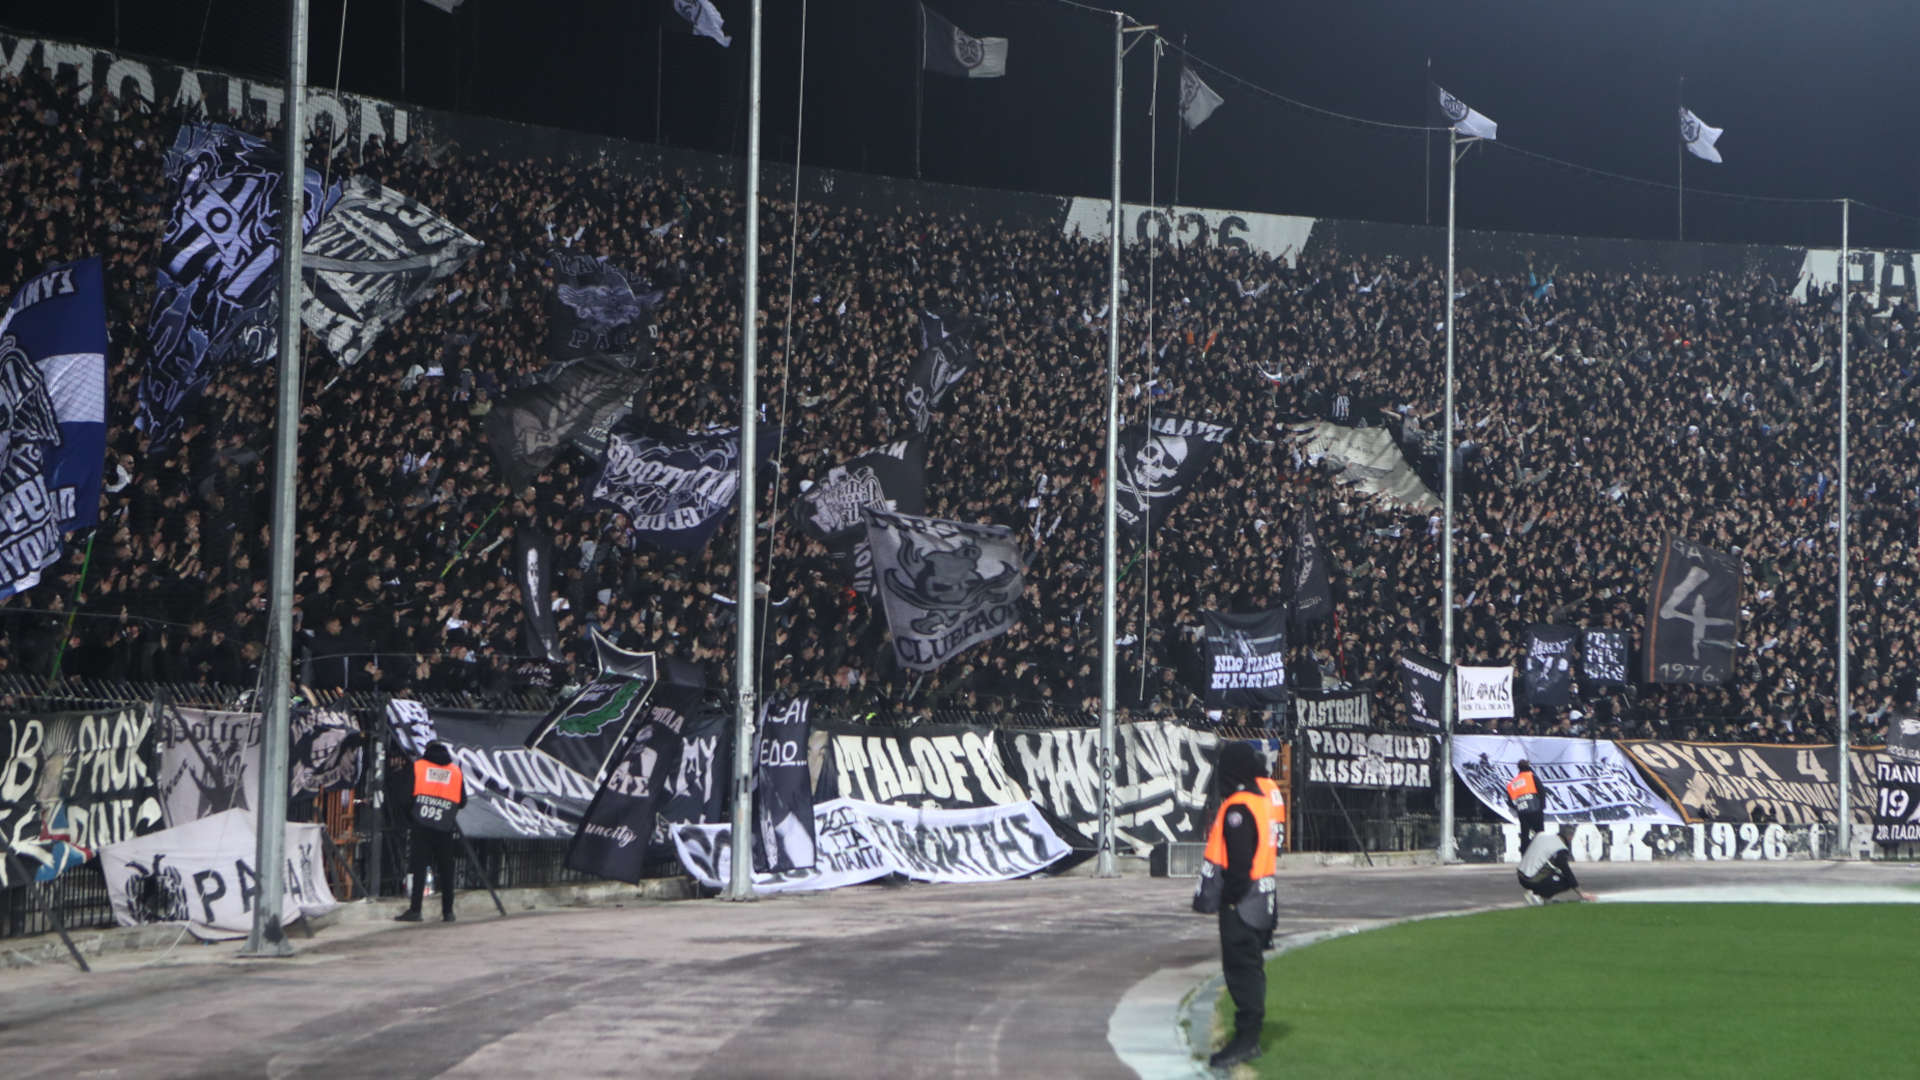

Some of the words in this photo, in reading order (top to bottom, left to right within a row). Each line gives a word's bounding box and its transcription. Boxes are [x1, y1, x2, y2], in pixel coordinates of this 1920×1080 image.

[1309, 757, 1432, 788] KASSANDRA
[1796, 750, 1830, 783] 4
[420, 805, 443, 821] 095
[1692, 821, 1789, 863] 1926
